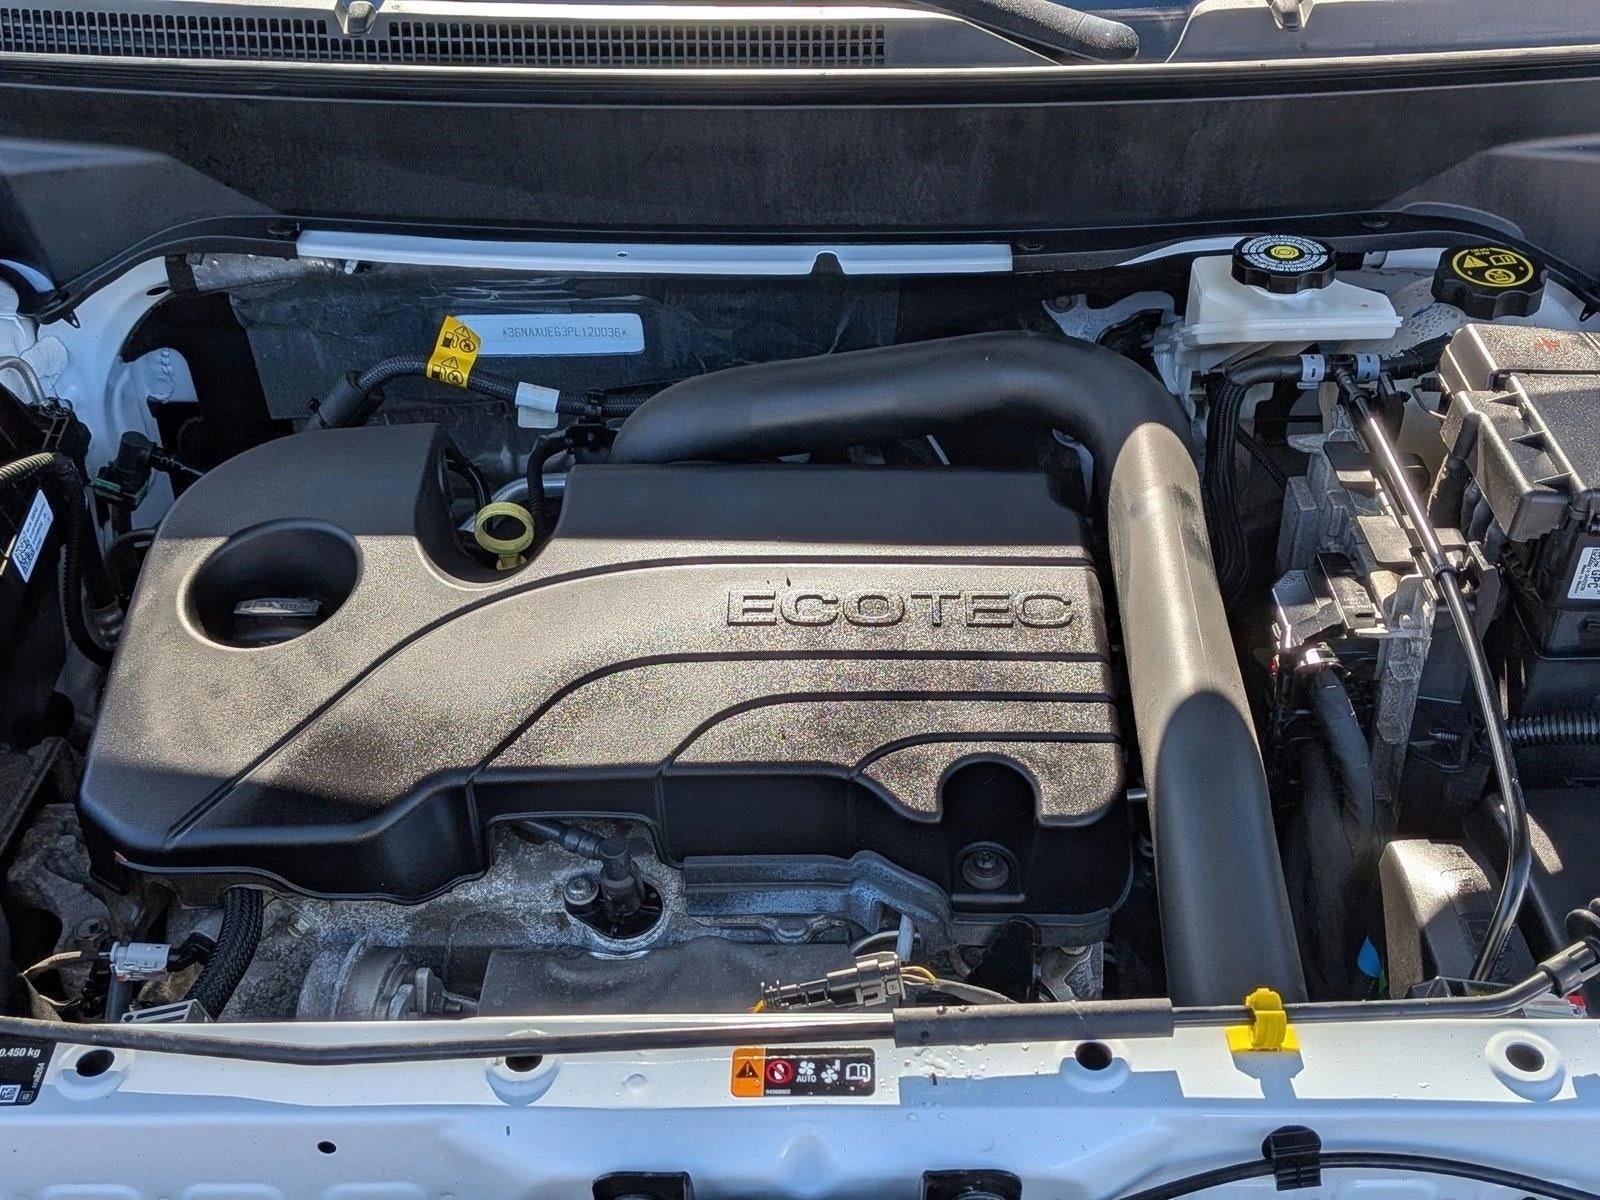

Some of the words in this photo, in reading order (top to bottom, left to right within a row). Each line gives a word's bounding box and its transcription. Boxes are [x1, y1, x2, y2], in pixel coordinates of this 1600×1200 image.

[727, 590, 1075, 629] ECOTEC
[0, 1047, 26, 1058] 0.450
[27, 1047, 41, 1059] kg
[796, 1074, 817, 1083] AUTO
